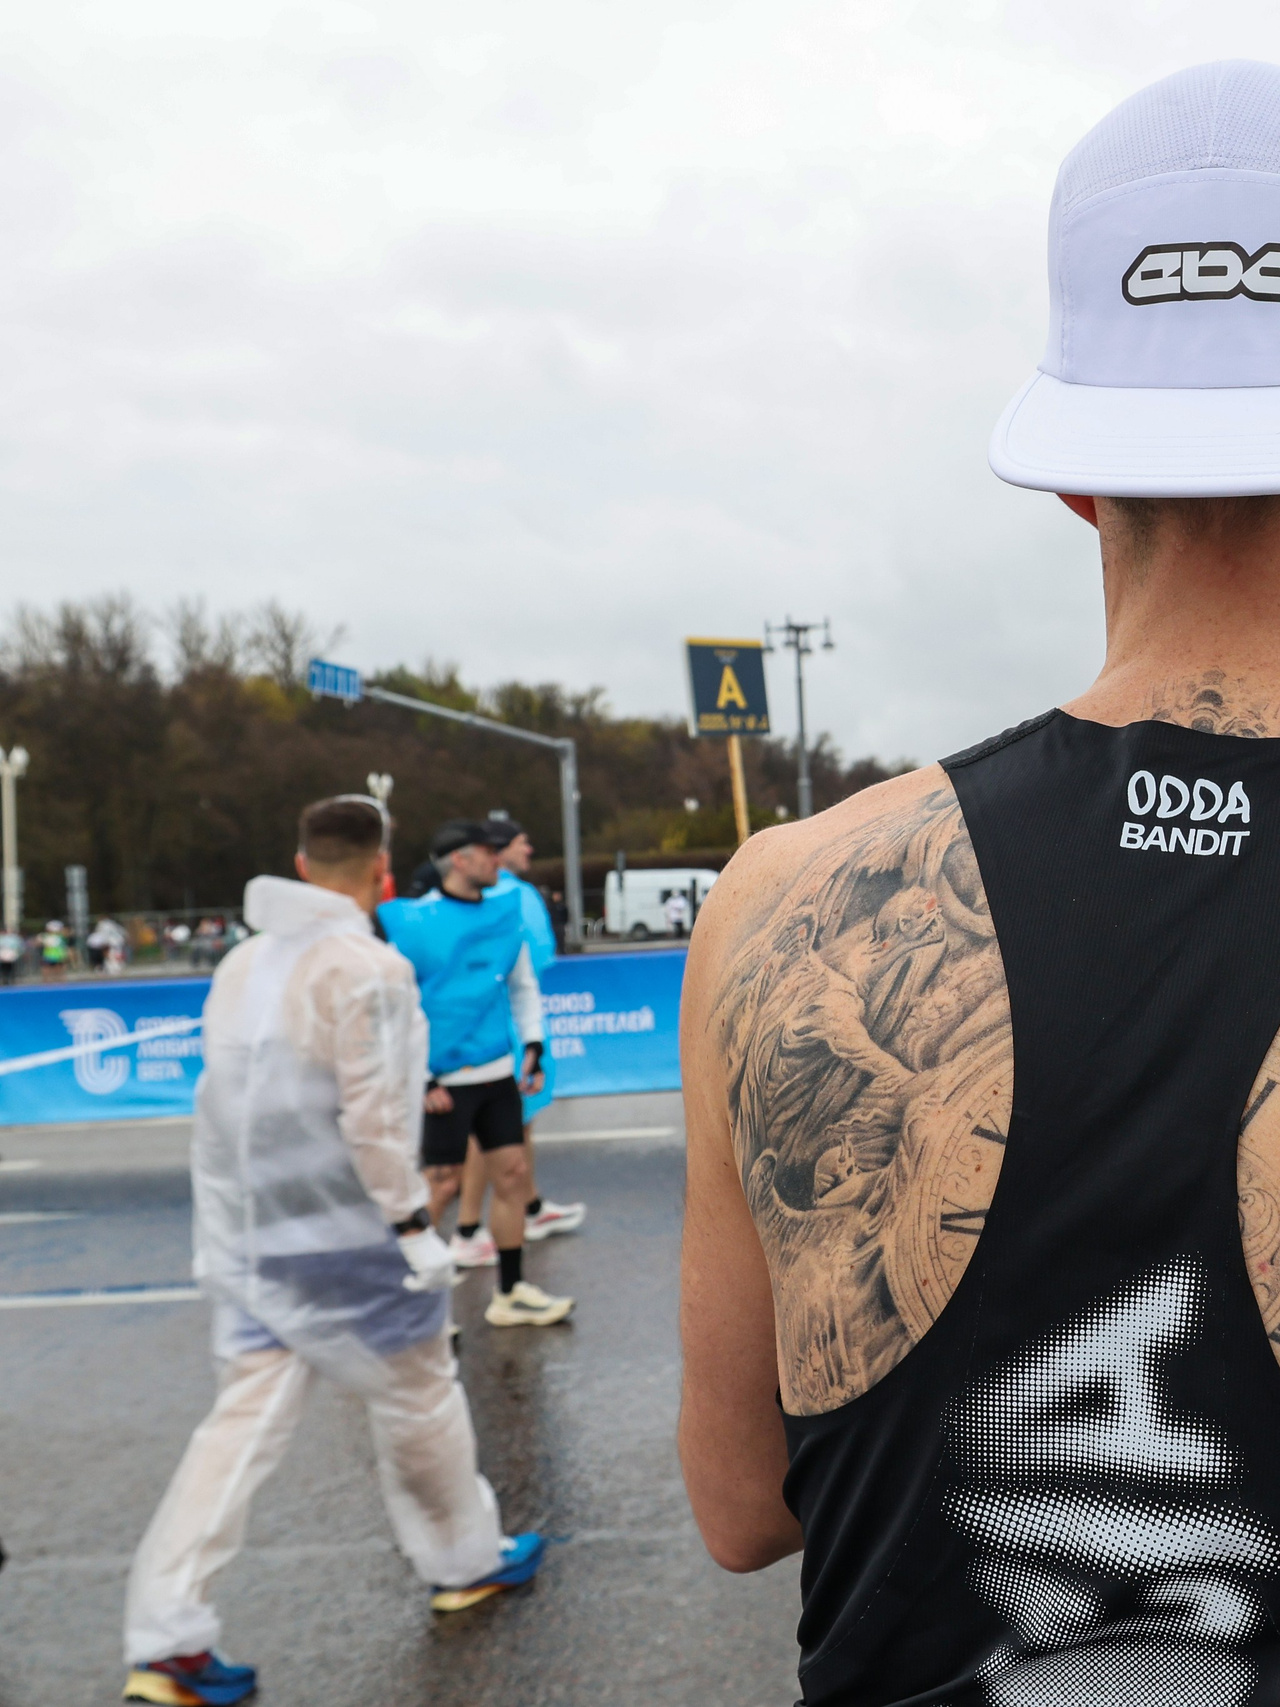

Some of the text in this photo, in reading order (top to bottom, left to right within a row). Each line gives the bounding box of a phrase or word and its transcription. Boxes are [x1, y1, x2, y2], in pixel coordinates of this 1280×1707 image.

[1127, 769, 1251, 824] ODDA
[1119, 821, 1251, 856] BANDIT
[549, 1005, 655, 1034] ЮБИТЕЛЕЙ
[549, 1037, 586, 1059] ЕГА
